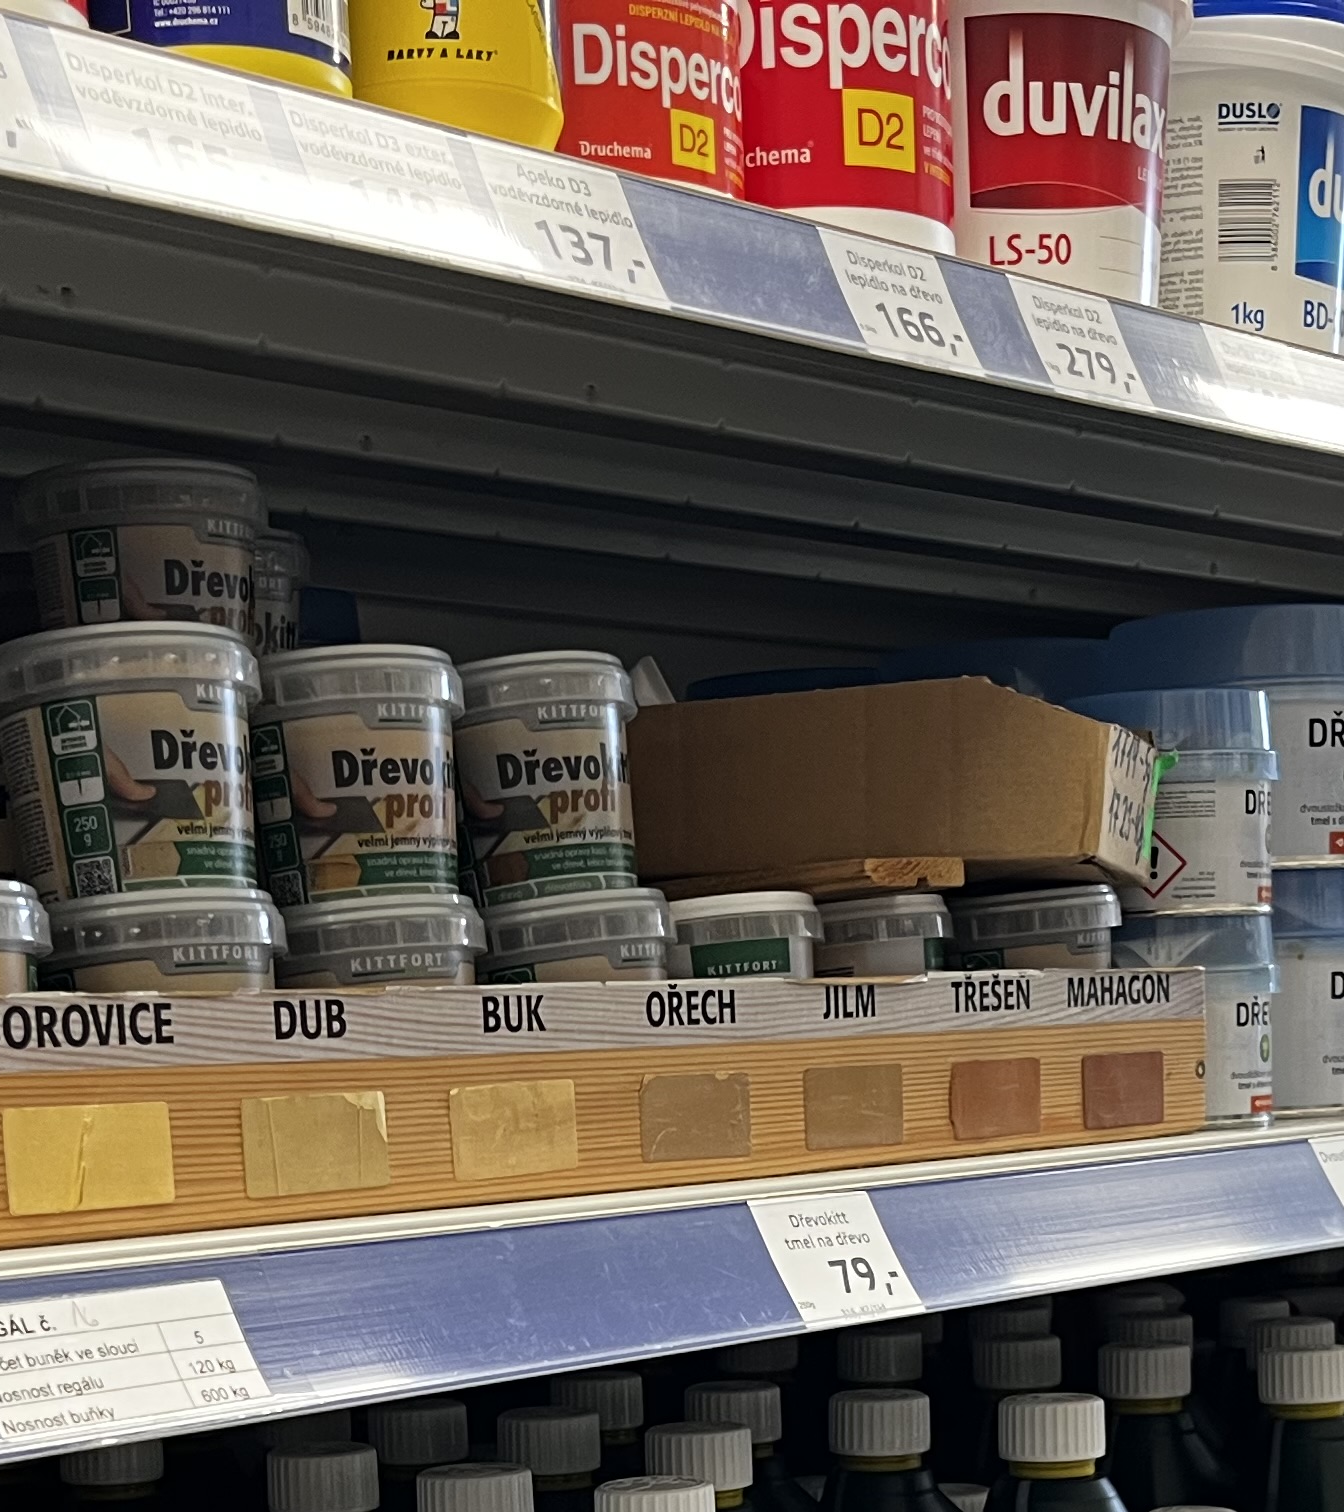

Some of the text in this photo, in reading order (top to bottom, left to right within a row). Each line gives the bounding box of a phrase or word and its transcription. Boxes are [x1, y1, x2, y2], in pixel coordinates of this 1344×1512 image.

[983, 46, 1166, 159] duvilax
[1217, 102, 1281, 120] DUSLO
[679, 124, 709, 158] D2
[856, 107, 905, 152] D2
[579, 140, 652, 160] Druchema
[515, 161, 592, 198] Apeko D3
[488, 178, 634, 229] voděvzdorné lepidlo
[533, 219, 647, 284] 137,-
[845, 249, 927, 281] Disperkol D2
[987, 232, 1072, 269] LS-50
[844, 270, 944, 306] lepidlo na dřevo
[875, 302, 964, 356] 166,-
[1230, 302, 1265, 331] 1kg
[1057, 342, 1137, 394] 279,-
[547, 788, 617, 828] profi
[645, 983, 738, 1029] OŘECH
[822, 984, 878, 1021] JILM
[950, 972, 1032, 1015] TŘEŠEŇ
[1066, 973, 1172, 1009] MAHAGON
[272, 1001, 348, 1041] DUB
[480, 993, 548, 1035] BUK
[788, 1211, 849, 1228] Dřevokitt
[785, 1231, 870, 1250] tmel na dřevo
[828, 1257, 898, 1295] 79,-
[40, 1314, 57, 1334] č.
[27, 1348, 74, 1371] buněk
[78, 1347, 95, 1363] ve
[193, 1329, 205, 1345] 5
[57, 1373, 106, 1398] regálu
[188, 1357, 215, 1375] 120
[218, 1355, 236, 1376] kg
[1, 1384, 250, 1436] Nosnost buňky 600 kg
